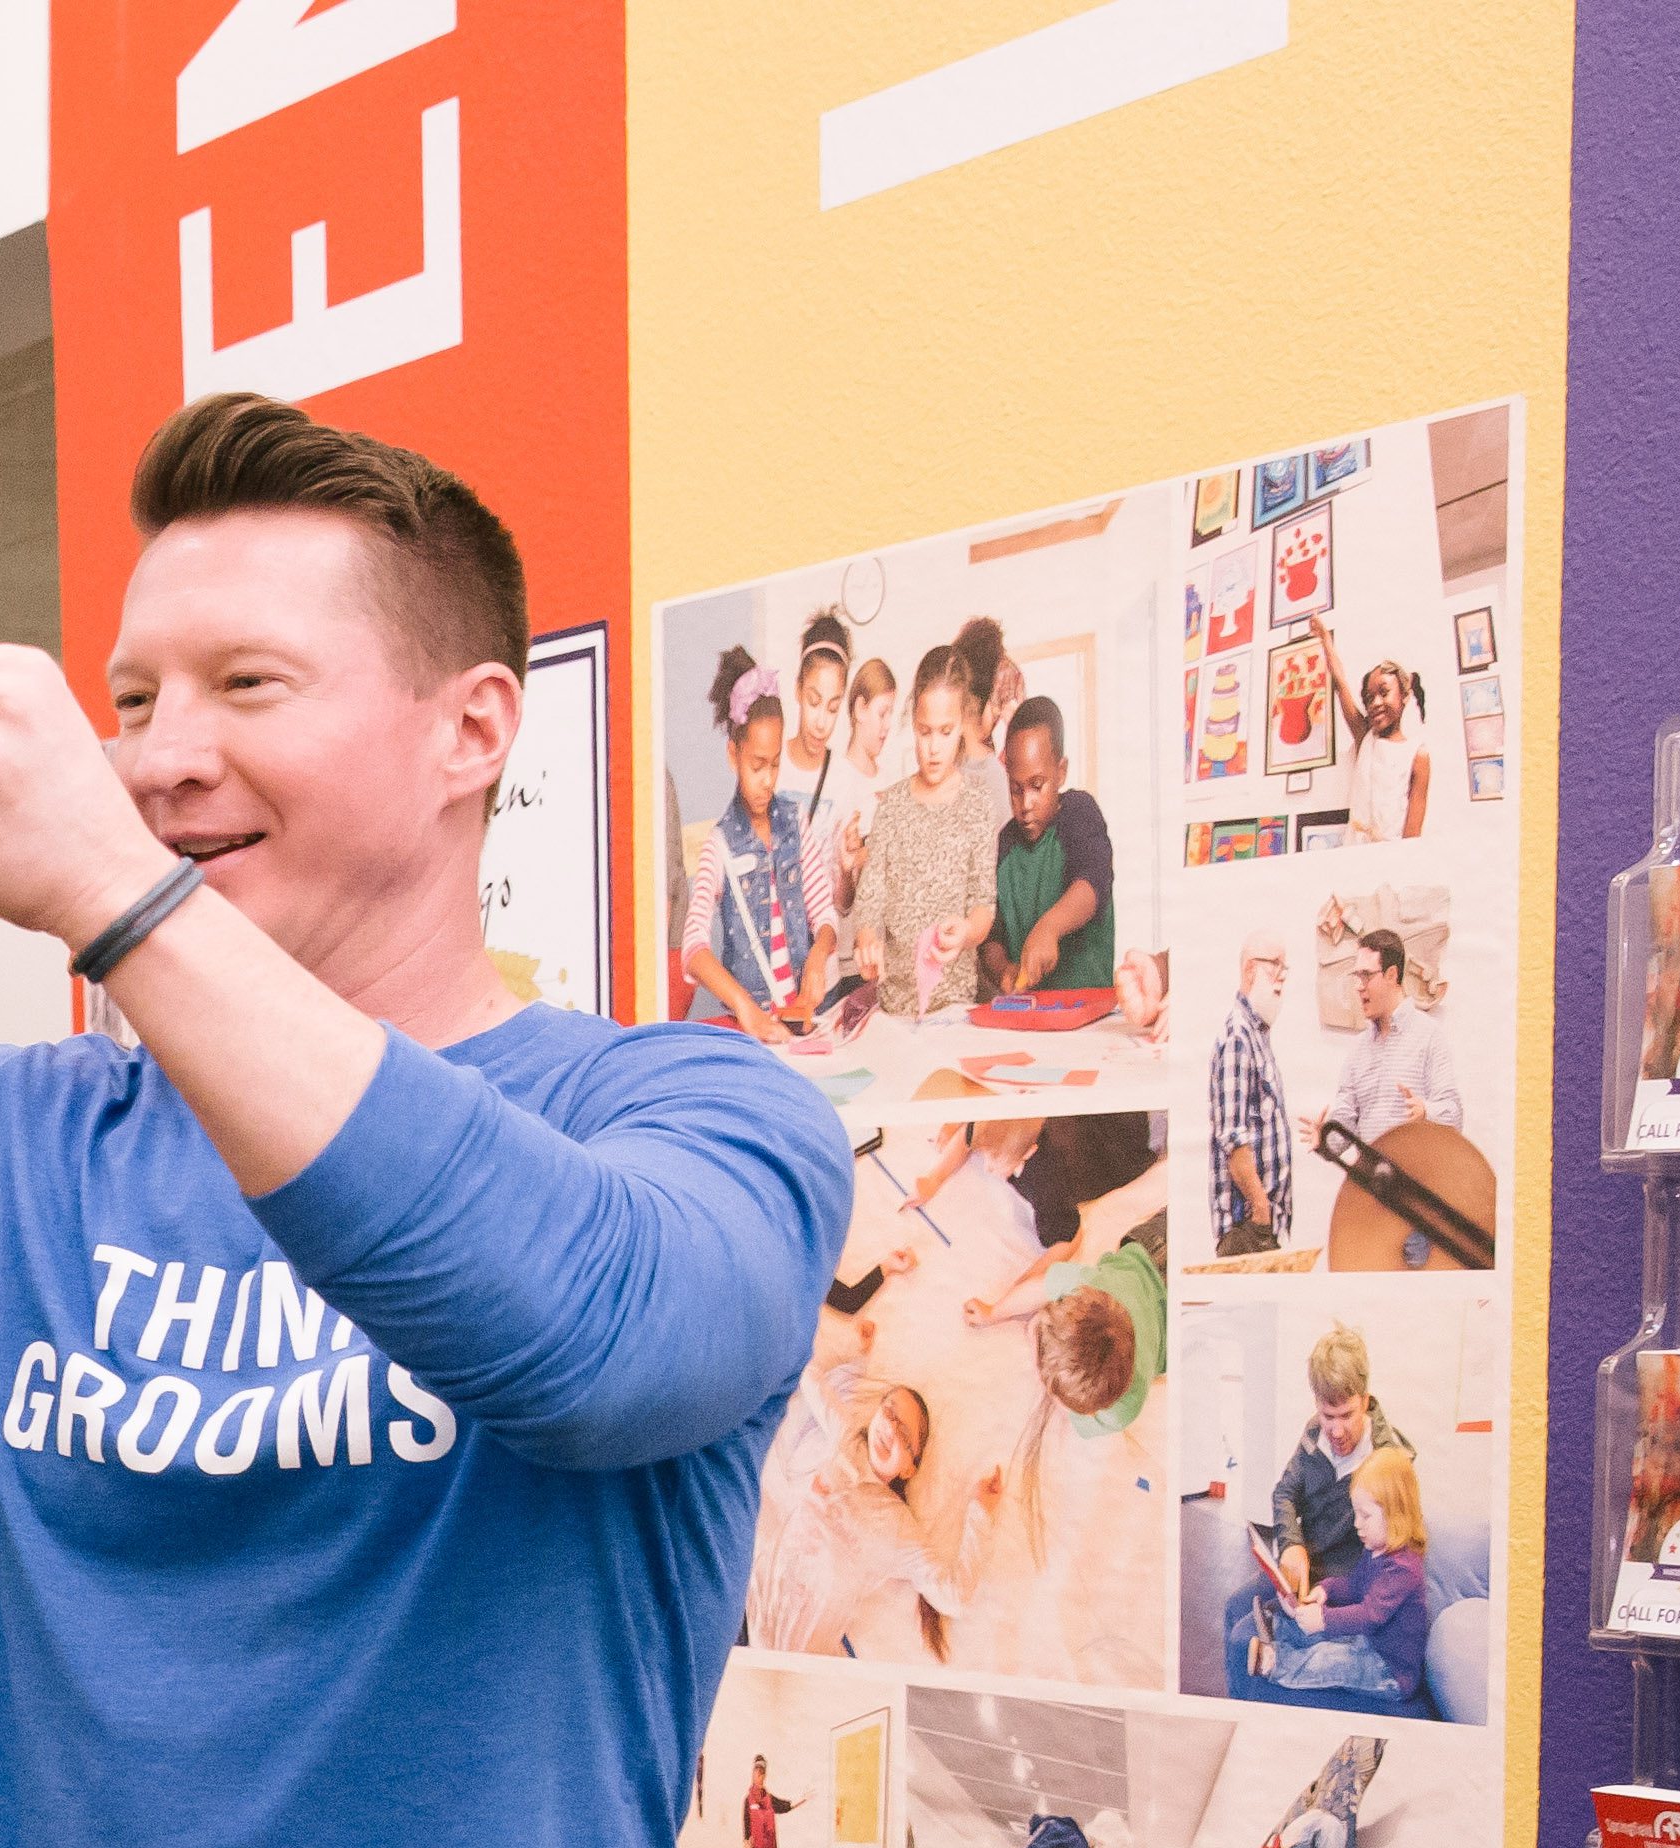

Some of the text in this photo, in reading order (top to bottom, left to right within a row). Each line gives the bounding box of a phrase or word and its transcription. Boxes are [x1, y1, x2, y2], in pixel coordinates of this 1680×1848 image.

[1637, 1123, 1670, 1140] CALL
[2, 1339, 457, 1476] GROOMS
[1617, 1604, 1652, 1621] CALL
